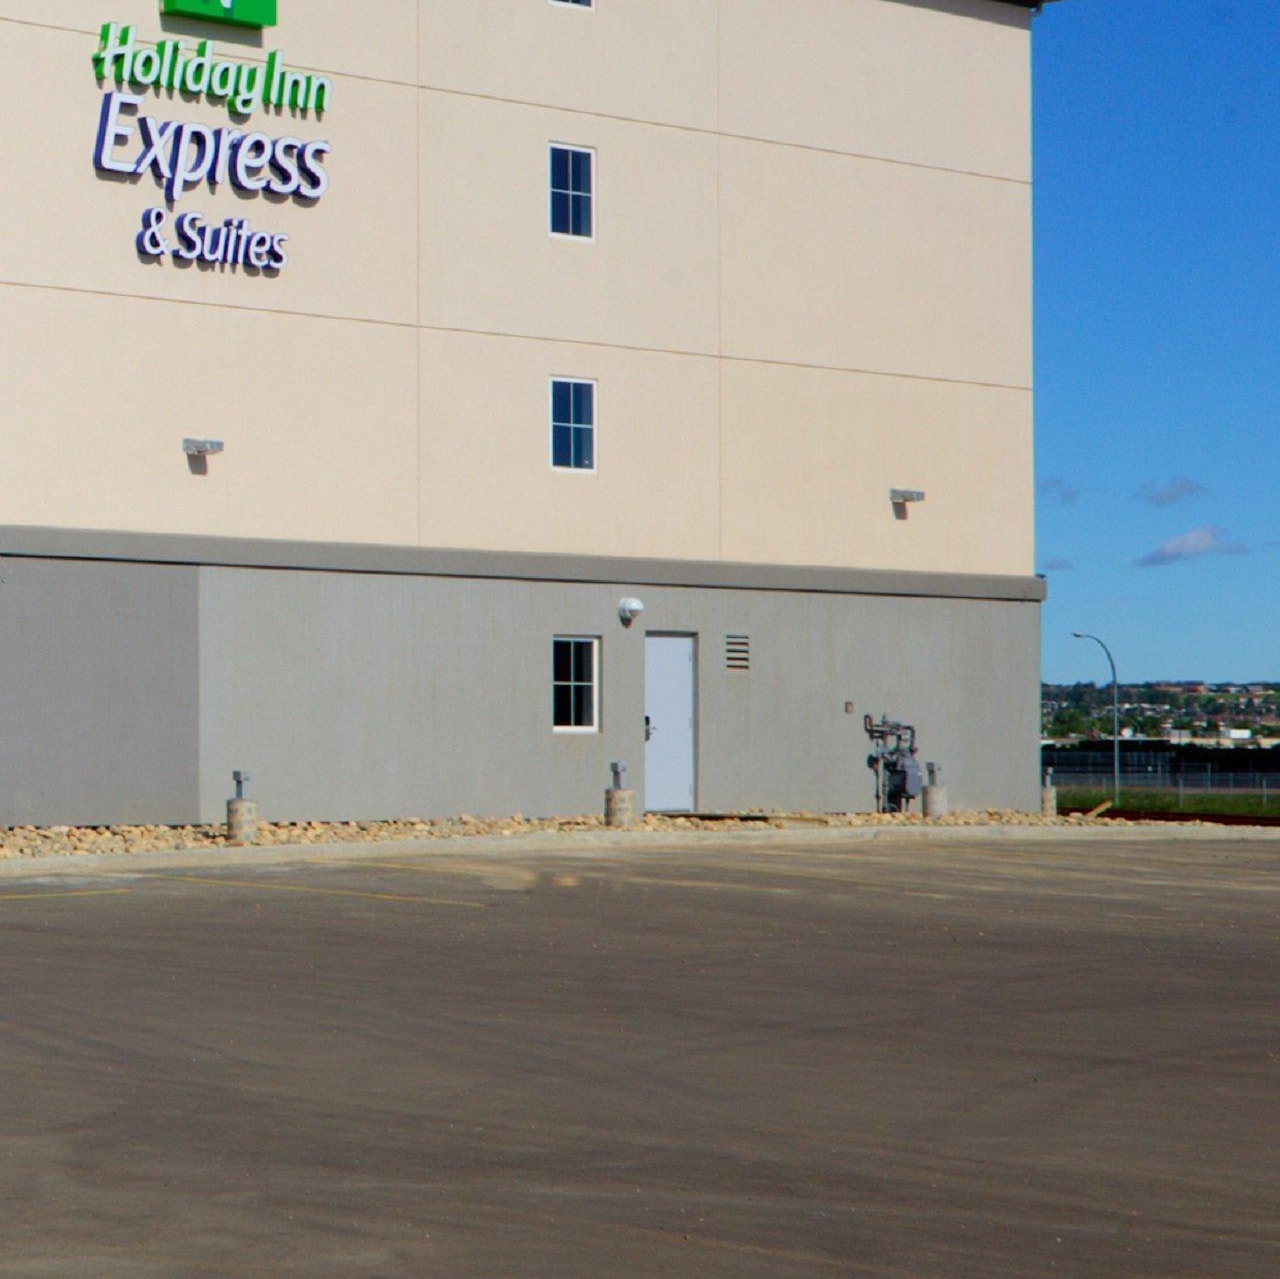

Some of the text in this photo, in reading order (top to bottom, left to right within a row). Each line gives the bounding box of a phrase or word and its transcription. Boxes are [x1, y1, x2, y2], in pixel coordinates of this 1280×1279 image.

[92, 22, 332, 114] Holiday Inn
[93, 91, 330, 200] Express
[136, 208, 288, 269] & Suites
